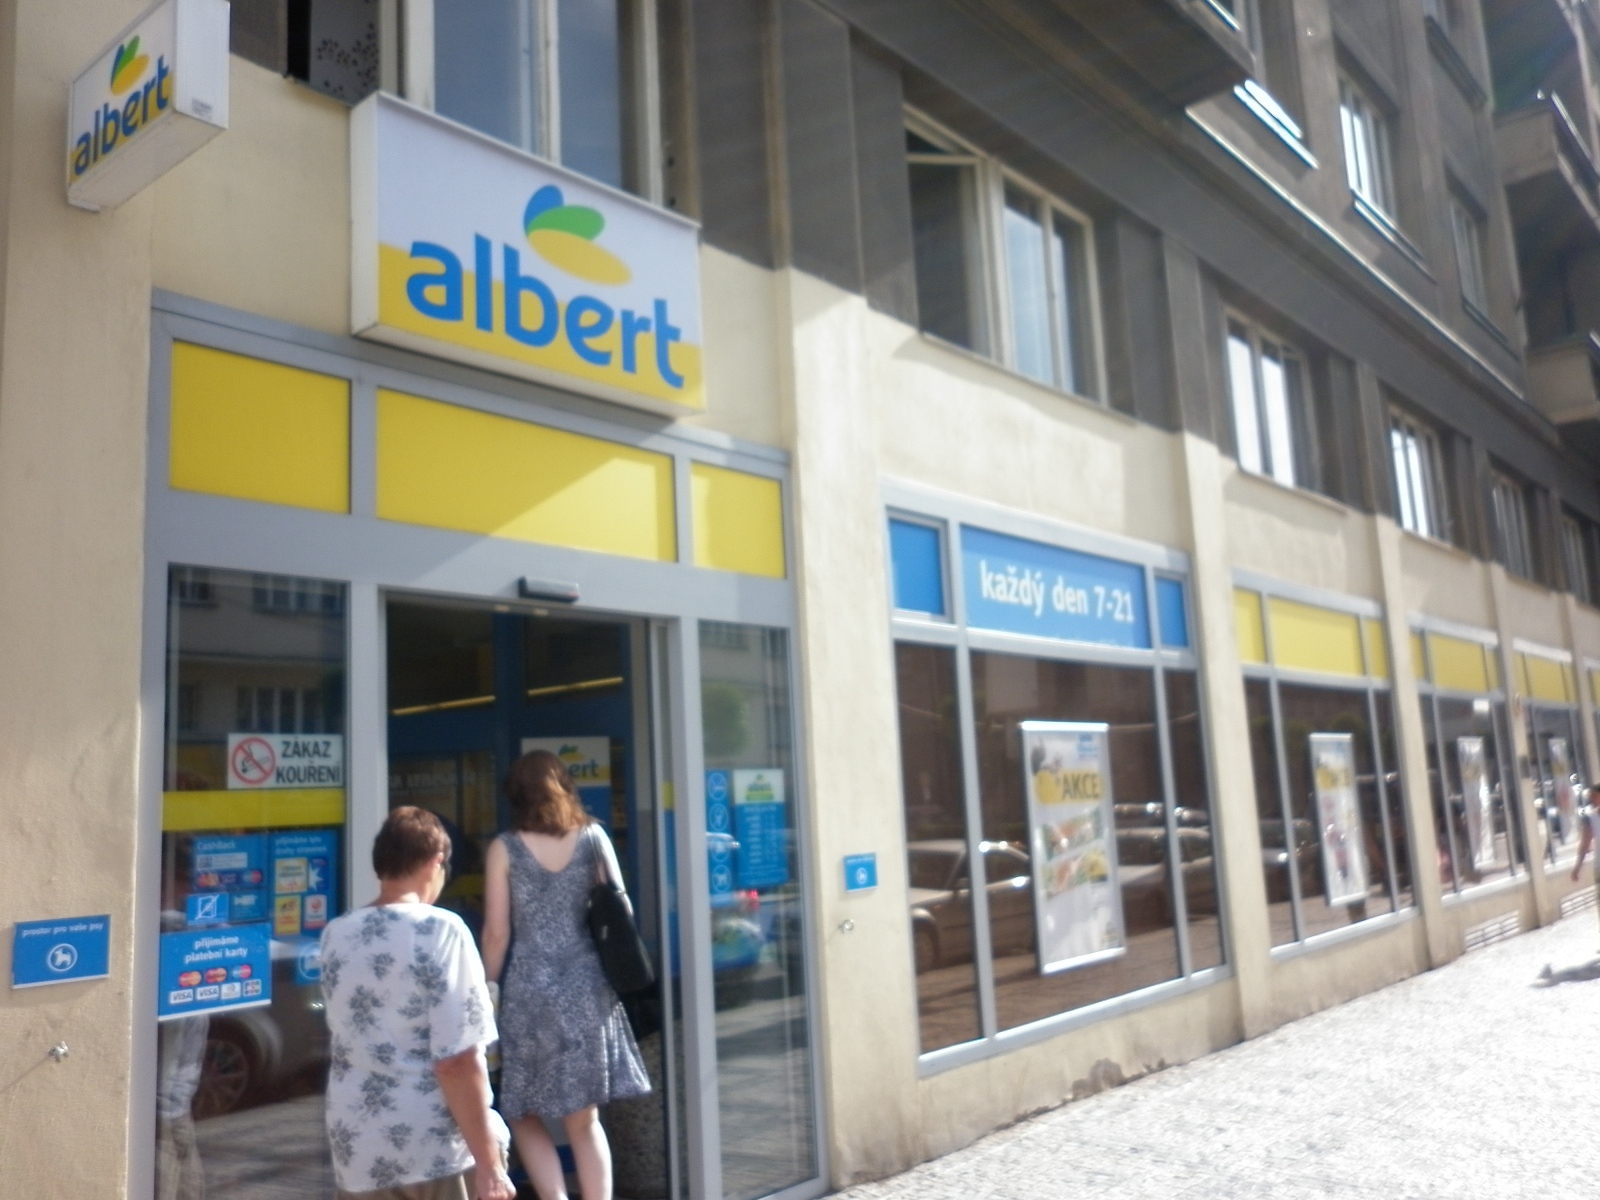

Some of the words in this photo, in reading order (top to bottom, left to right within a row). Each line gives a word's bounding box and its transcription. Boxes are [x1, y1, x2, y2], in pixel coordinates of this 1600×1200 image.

[74, 53, 169, 176] albert
[406, 232, 685, 389] albert
[979, 559, 1045, 618] každý
[1052, 575, 1088, 615] den
[1094, 585, 1136, 623] 7-21
[281, 737, 332, 759] ZÁKAZ
[275, 760, 341, 785] KOUŘENÍ
[225, 946, 249, 959] karty
[172, 991, 193, 1002] VISA
[199, 987, 219, 998] VISA
